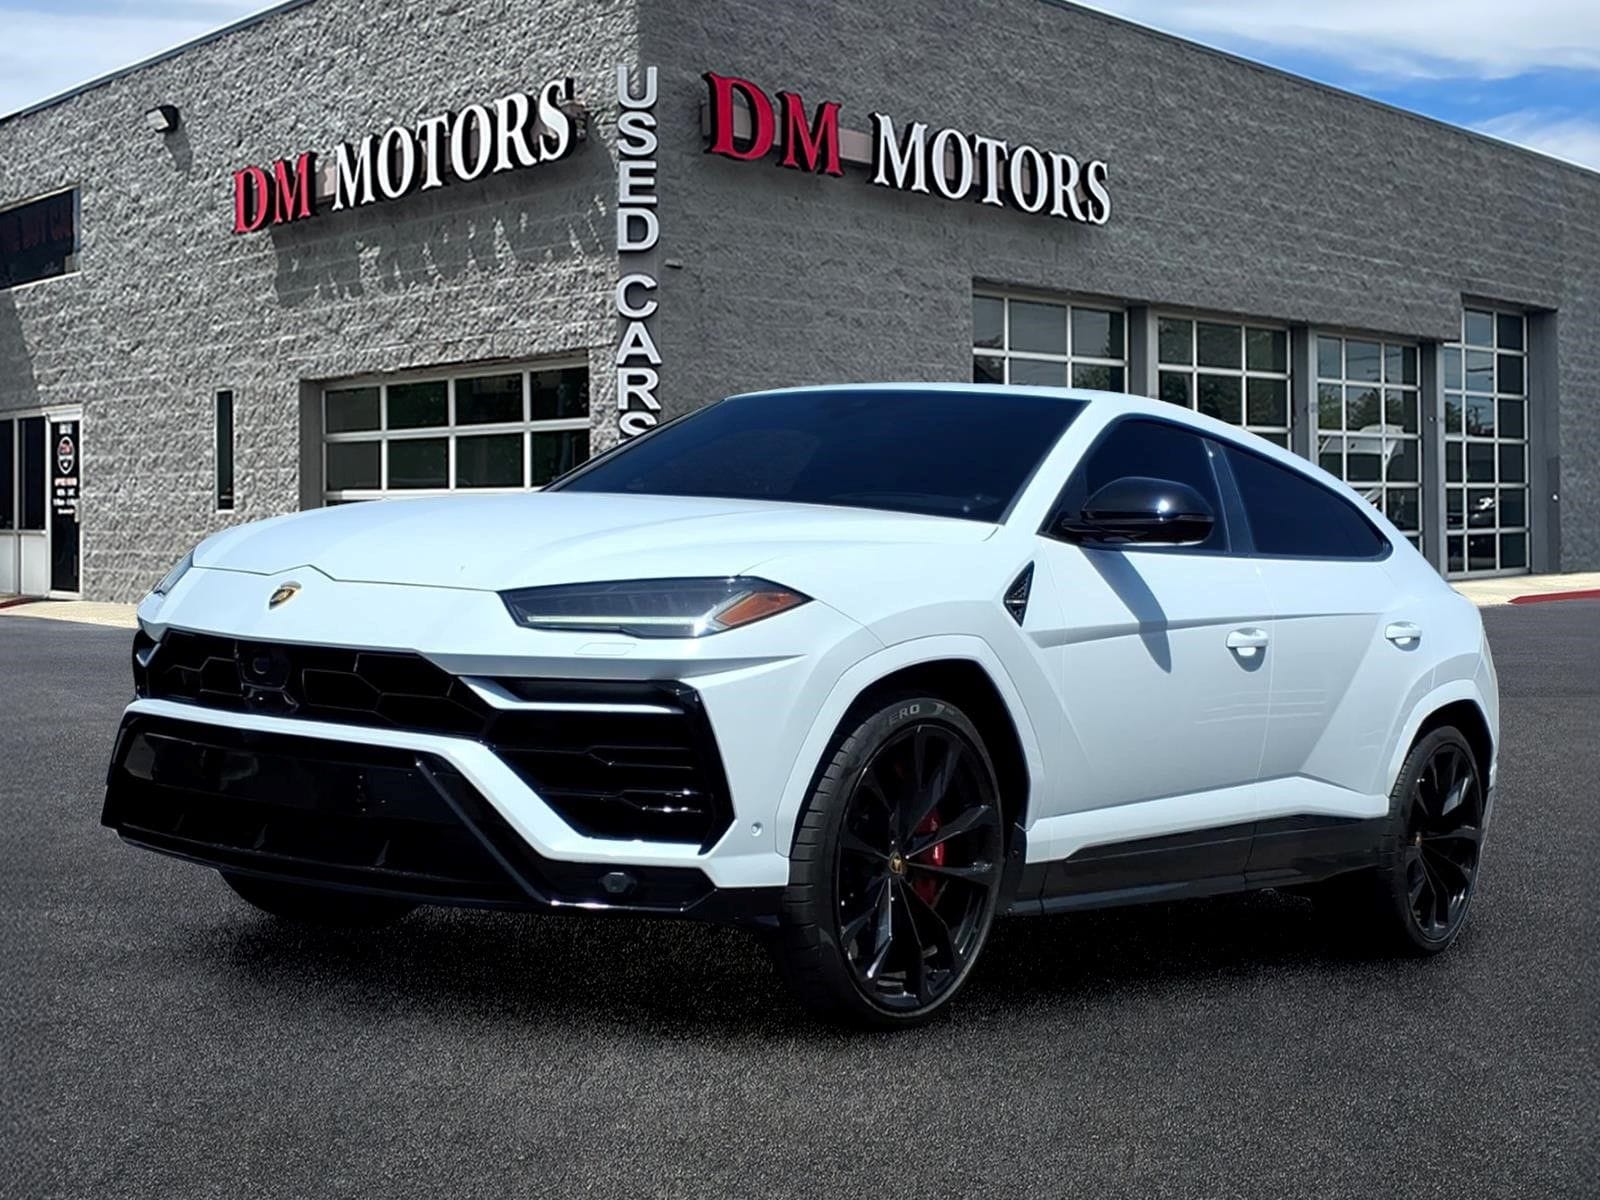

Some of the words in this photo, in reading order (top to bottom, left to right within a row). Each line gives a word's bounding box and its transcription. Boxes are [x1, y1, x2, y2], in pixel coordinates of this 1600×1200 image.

[233, 151, 315, 234] DM
[331, 79, 574, 211] MOTORS
[615, 65, 661, 252] USED
[703, 71, 844, 178] DM
[871, 111, 1112, 226] MOTORS
